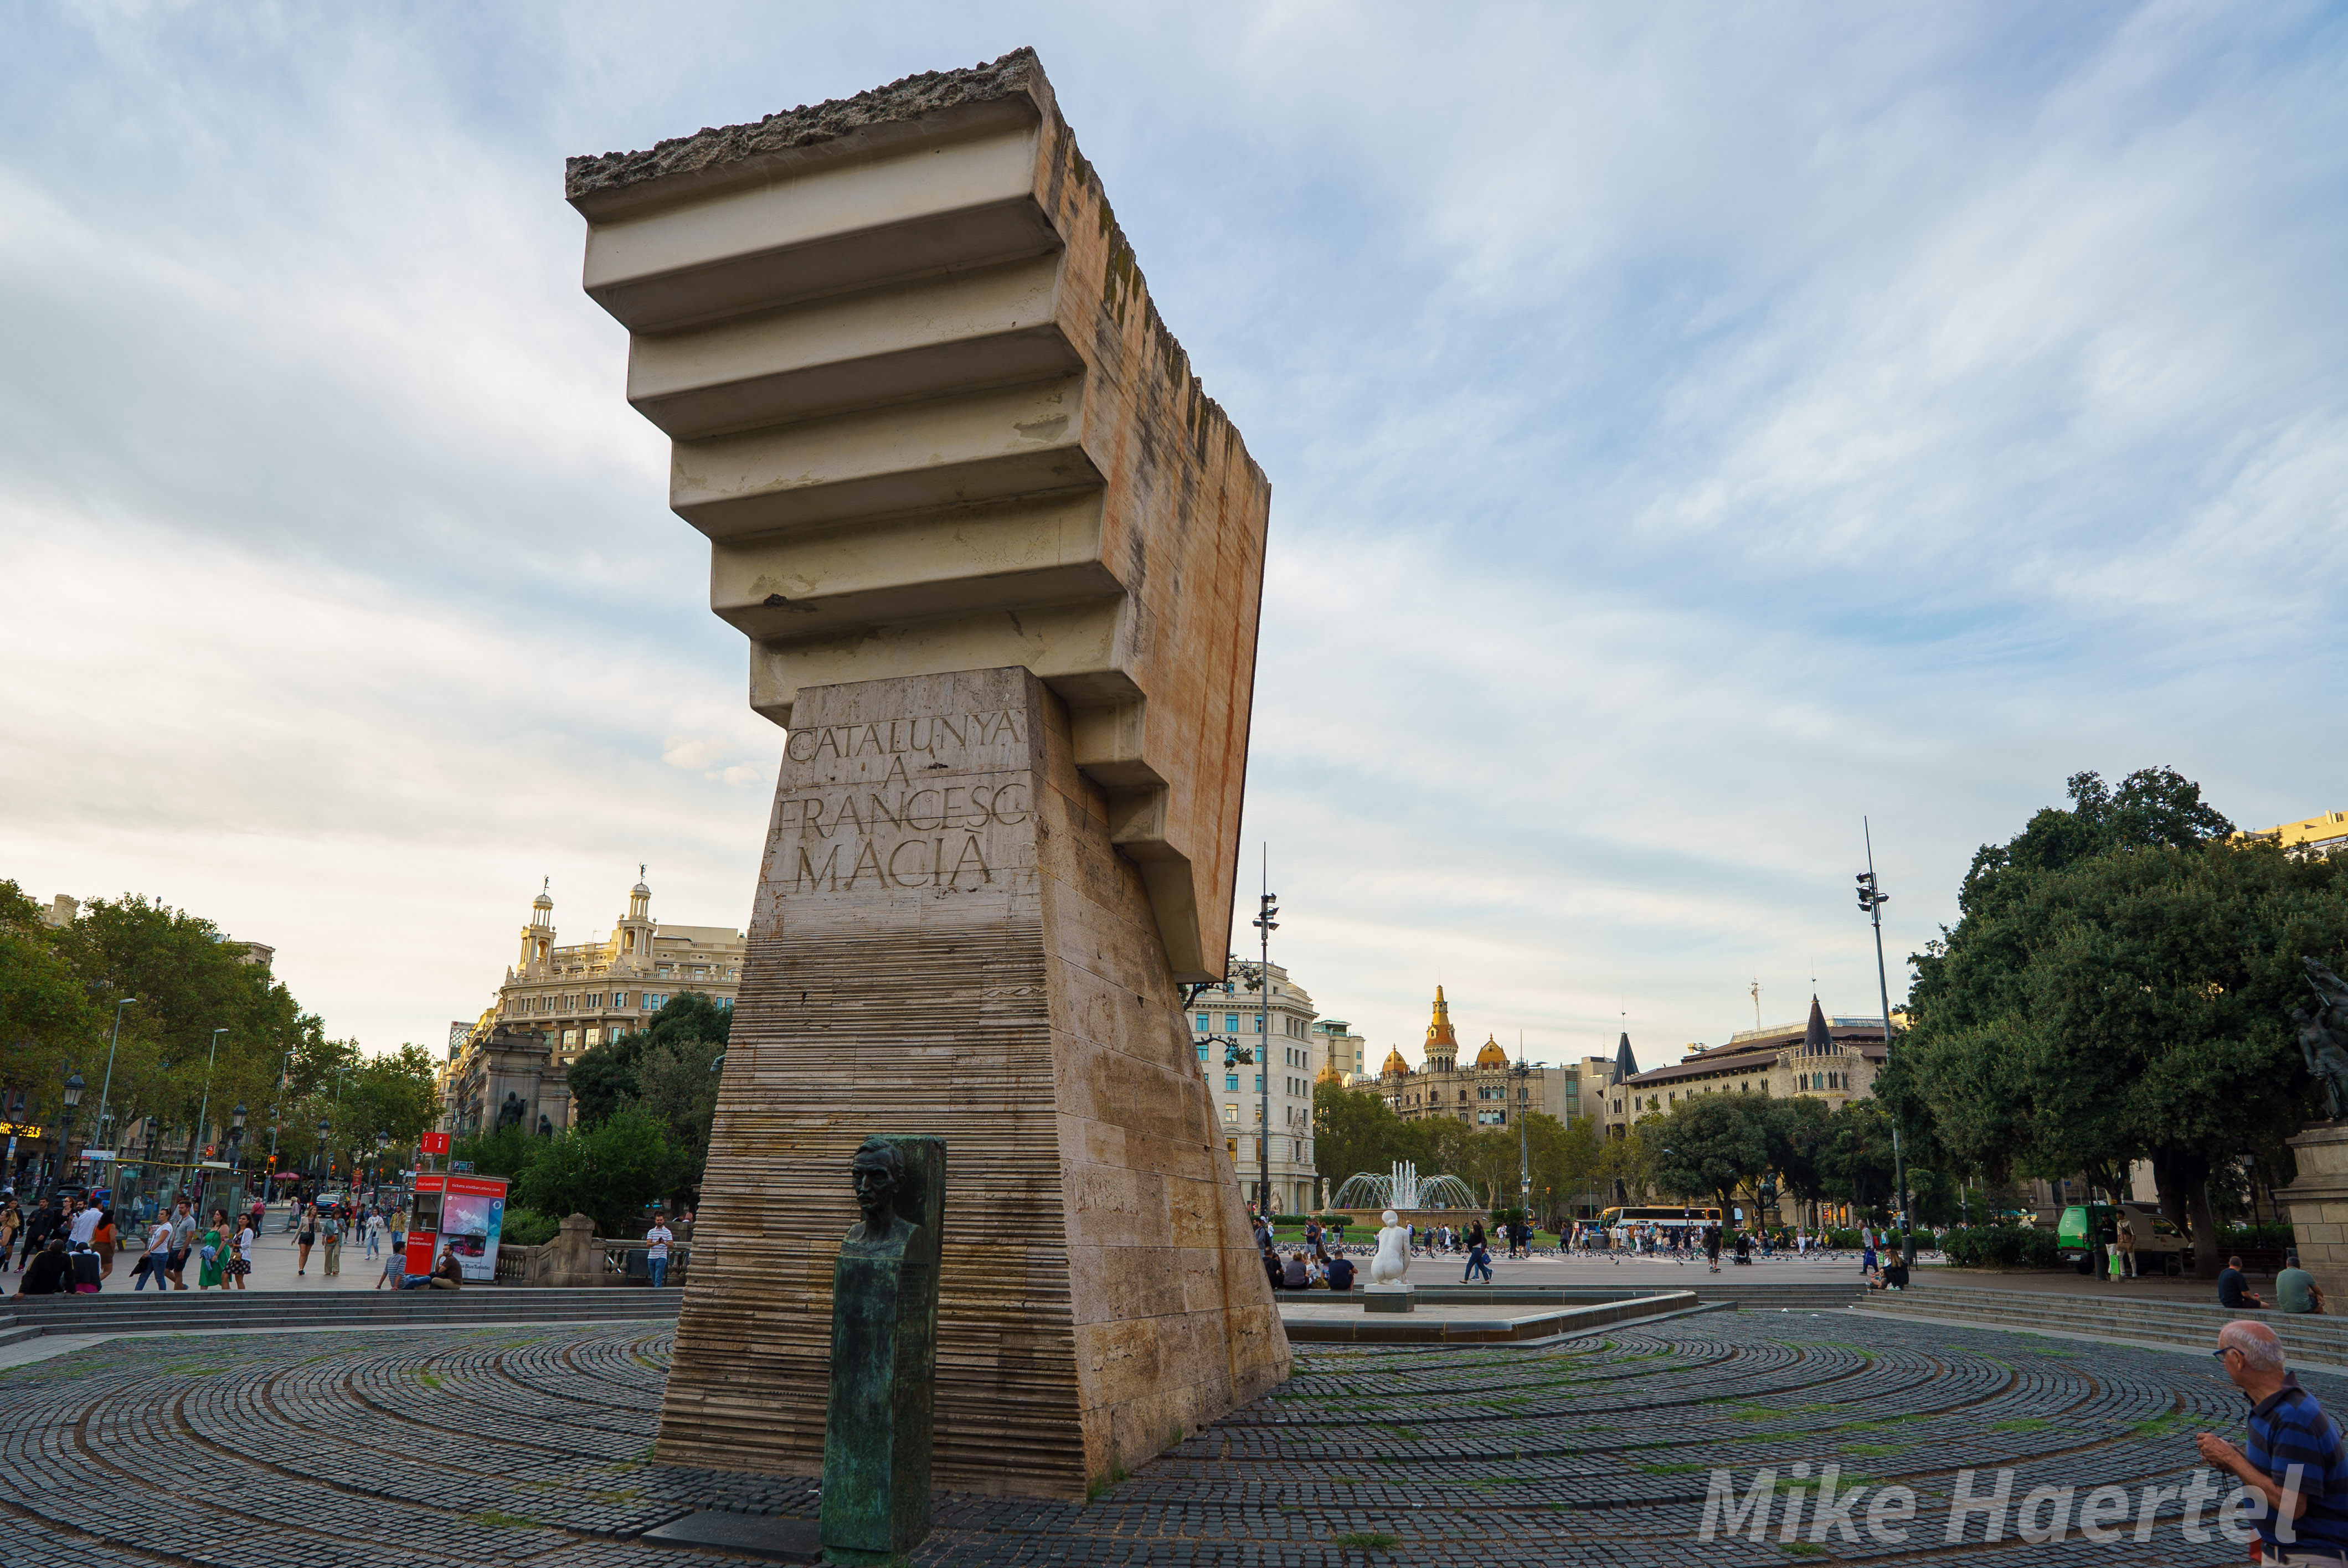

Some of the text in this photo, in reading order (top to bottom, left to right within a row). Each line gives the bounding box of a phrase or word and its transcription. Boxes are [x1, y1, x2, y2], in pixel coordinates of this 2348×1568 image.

[786, 709, 1022, 762] CATALUNYA
[883, 755, 912, 790] A
[775, 782, 1028, 841] FRANCESC
[794, 828, 995, 894] MACIÀ
